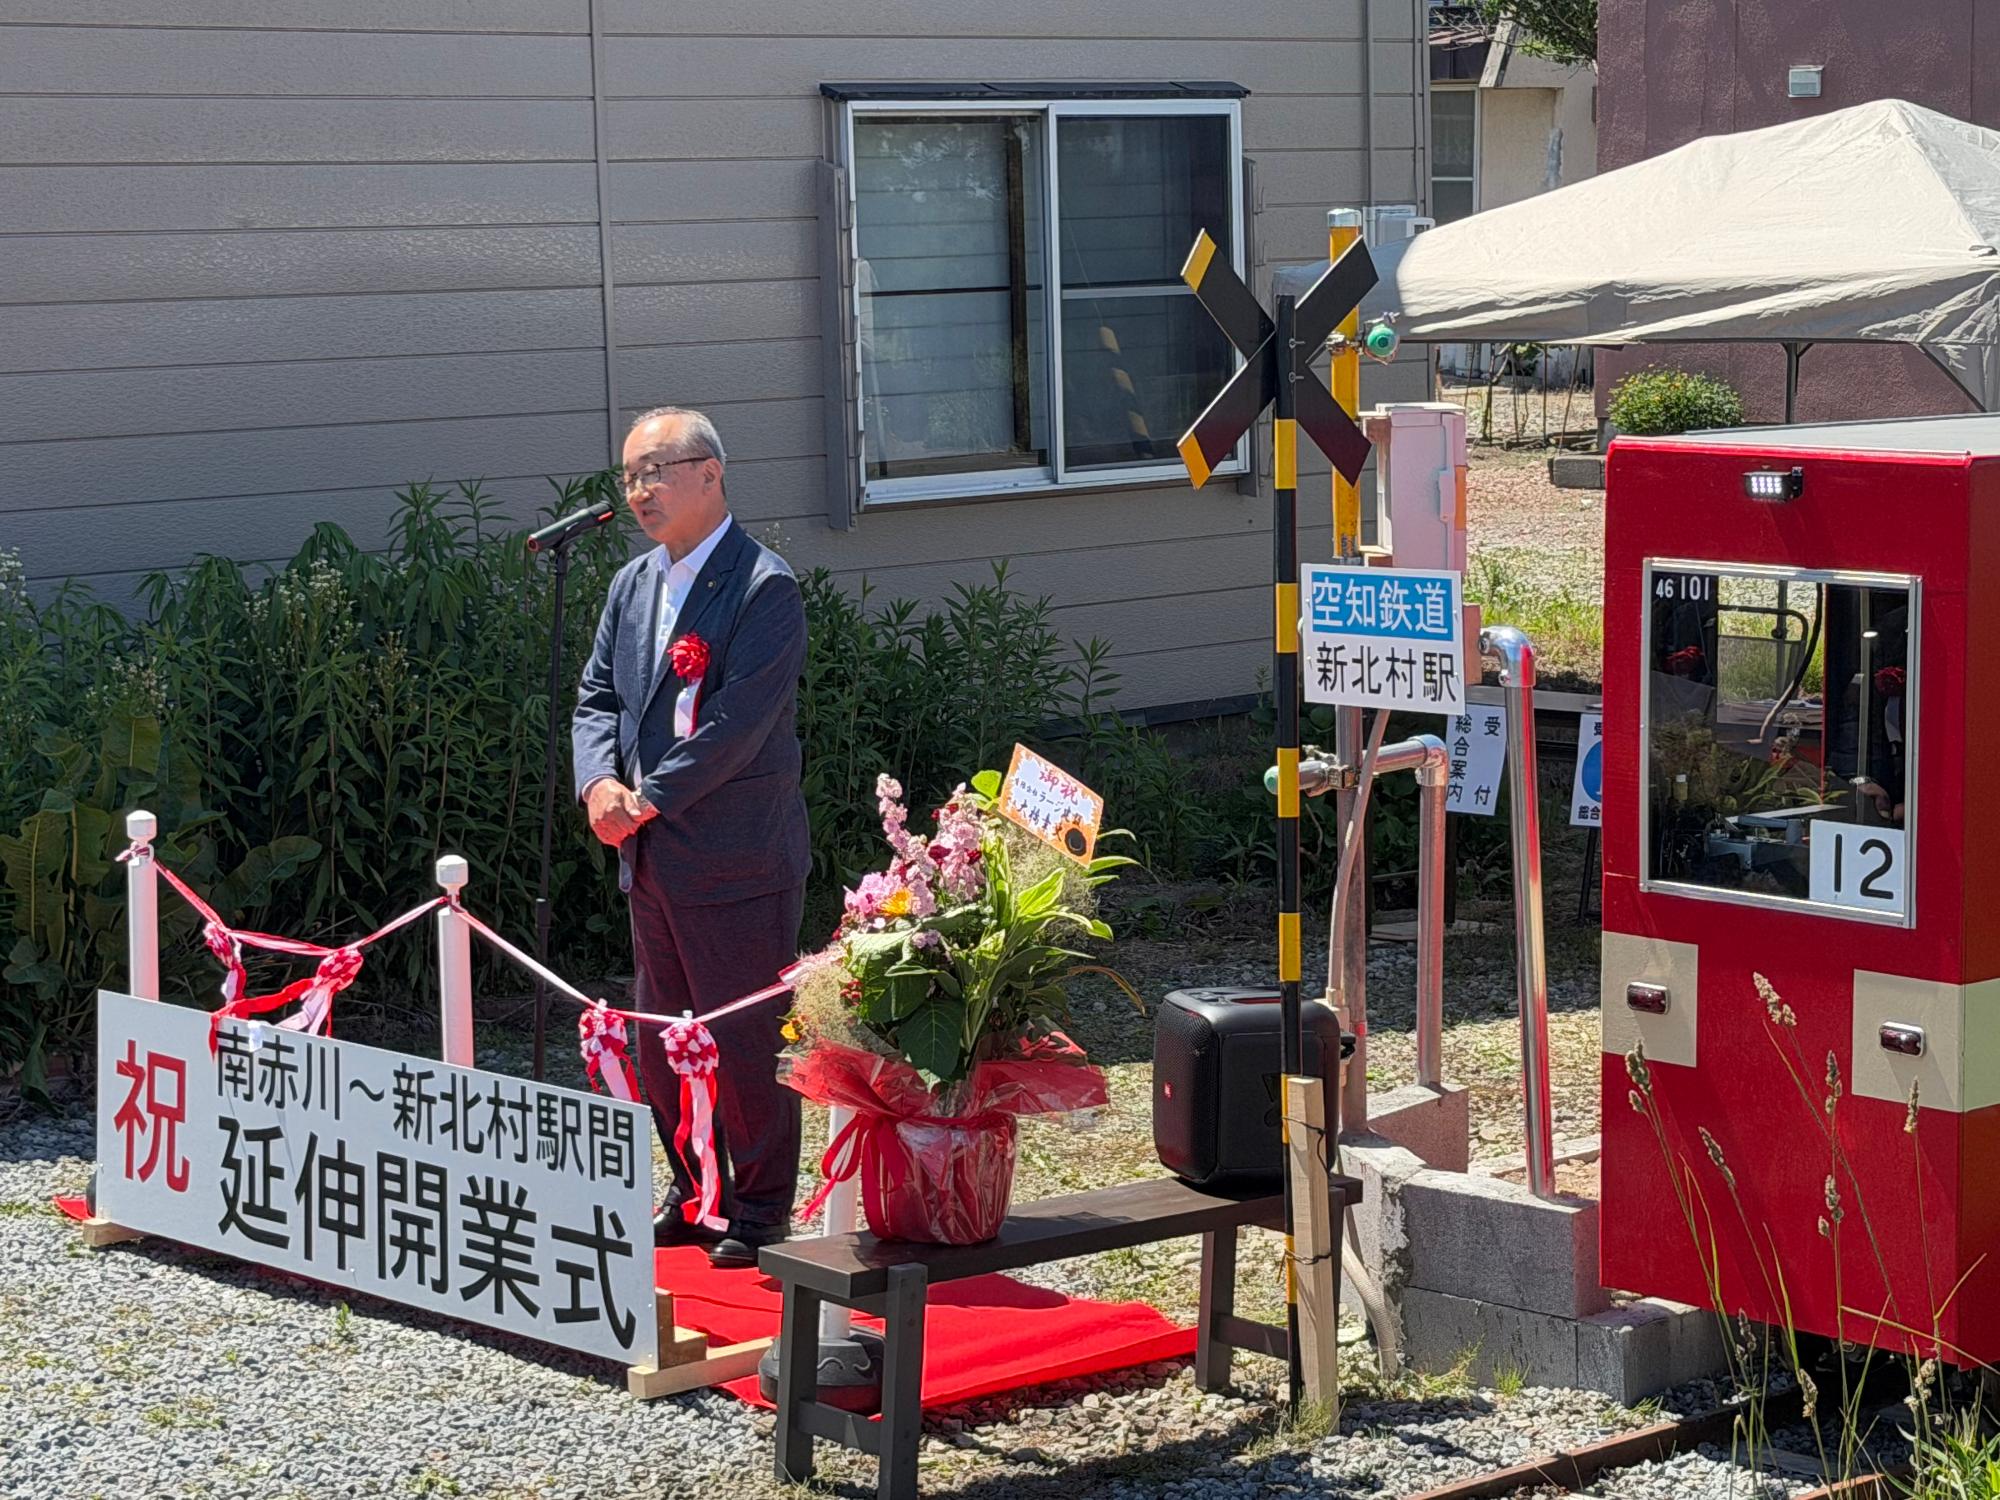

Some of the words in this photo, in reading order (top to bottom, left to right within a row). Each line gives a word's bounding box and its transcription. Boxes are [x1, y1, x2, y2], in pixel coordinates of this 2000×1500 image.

[1655, 578, 1674, 598] 46
[1681, 575, 1710, 600] 101
[1316, 641, 1457, 702] 新北村駅
[1446, 713, 1473, 803] 総合案内
[1833, 833, 1894, 900] 12
[113, 1039, 191, 1193] 祝
[217, 1115, 638, 1350] 延伸開業式
